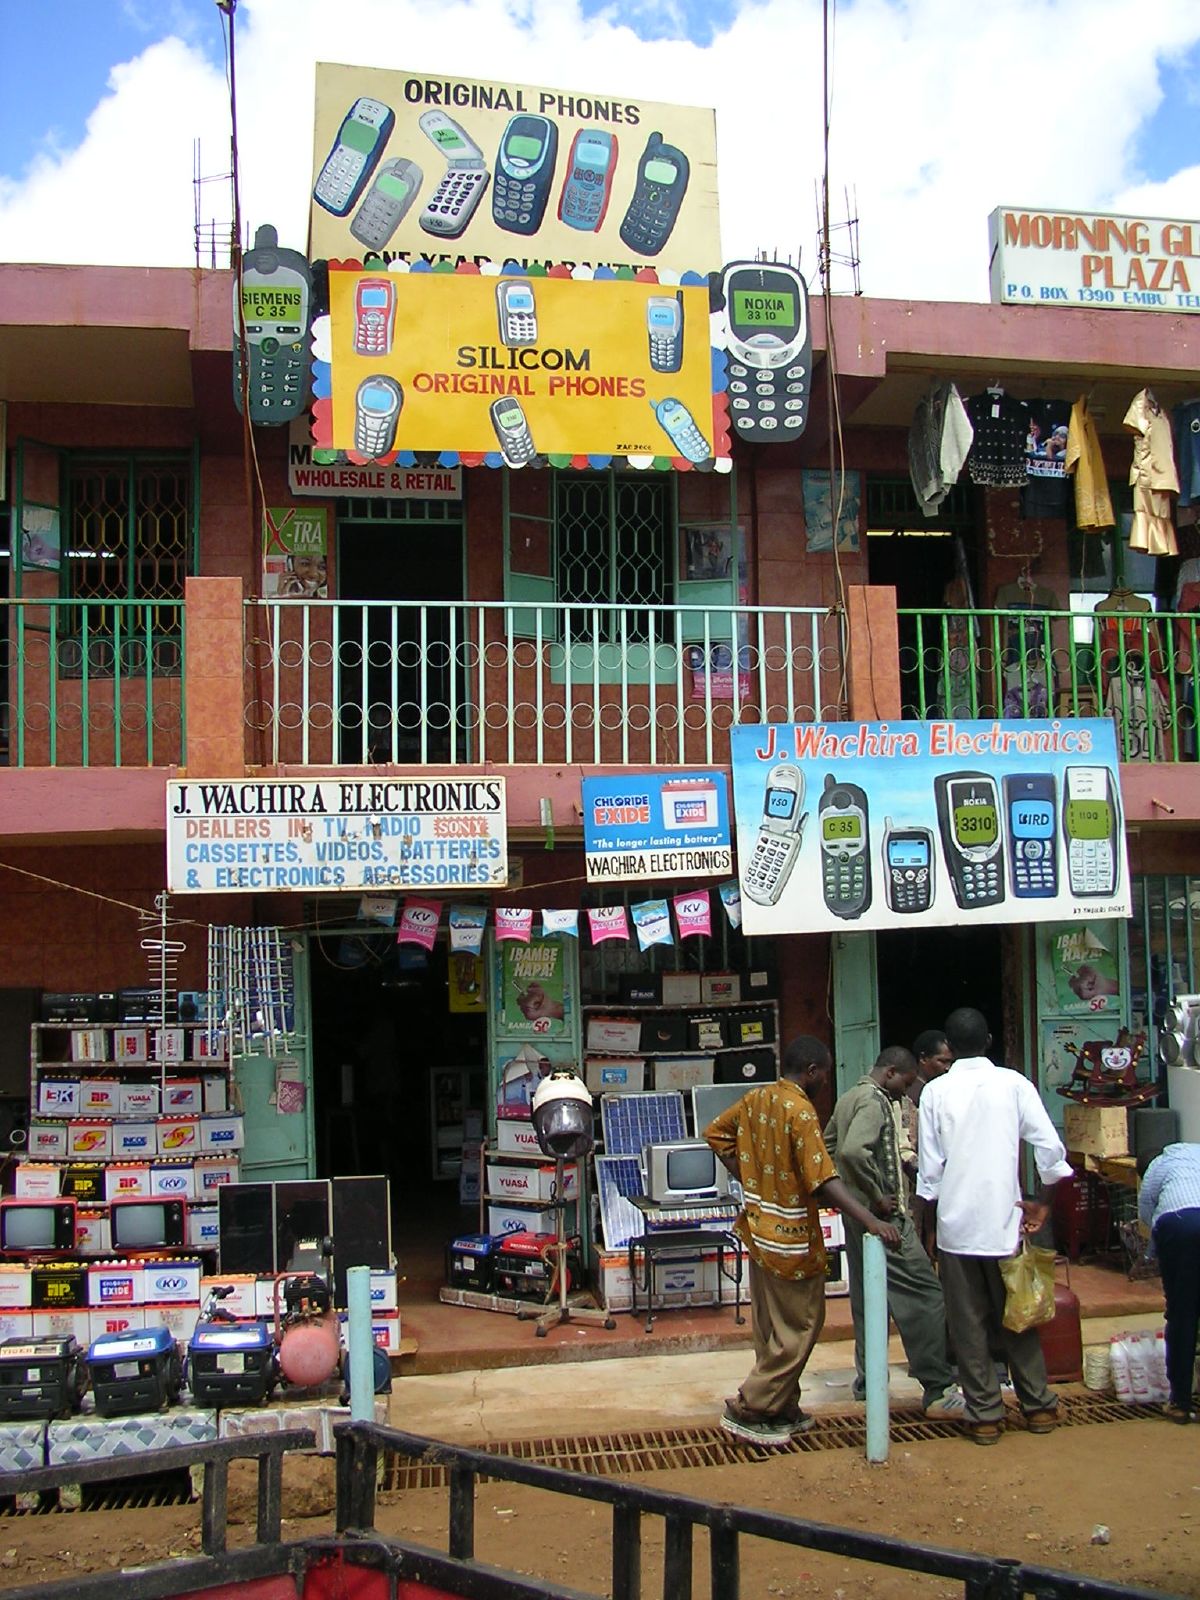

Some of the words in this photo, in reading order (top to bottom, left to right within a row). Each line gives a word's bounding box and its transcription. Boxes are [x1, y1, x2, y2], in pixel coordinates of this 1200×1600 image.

[404, 78, 528, 112] ORIGINAL
[540, 92, 641, 126] PHONES
[1005, 212, 1150, 255] MORNING
[1081, 254, 1191, 292] PLAZA
[242, 292, 302, 306] SIEMENS
[1039, 286, 1069, 300] BOX
[1077, 289, 1114, 303] 1390
[1122, 291, 1167, 306] EMBU
[744, 298, 785, 312] NOKIA
[456, 345, 591, 371] SILICOM
[412, 373, 536, 397] ORIGINAL
[549, 376, 646, 397] PHONES
[295, 470, 385, 488] WHOLESALE
[390, 473, 402, 490] &
[405, 473, 456, 491] RETAIL
[756, 727, 788, 760] J.
[794, 724, 920, 760] Wachira
[928, 720, 1093, 756] Electronics
[173, 785, 191, 814] J.
[201, 784, 328, 814] WACHIRA
[338, 782, 501, 813] ELECTRONICS
[593, 795, 649, 807] CHLORIDE
[963, 797, 987, 806] NOKIA
[593, 806, 651, 826] EXIDE
[676, 808, 705, 818] EXIDE
[185, 818, 271, 839] DEALERS
[365, 816, 422, 838] RADIO
[436, 818, 484, 836] SONY
[961, 816, 992, 832] 3310
[616, 837, 647, 850] longer
[650, 835, 682, 847] lasting
[185, 841, 303, 864] CASSETTES,
[315, 840, 389, 863] VIDEOS,
[400, 839, 501, 860] BATTERIES
[587, 855, 647, 876] WACHIRA
[650, 850, 730, 873] ELECTRONICS
[186, 867, 200, 888] &
[216, 864, 345, 888] ELECTRONICS
[362, 863, 490, 886] ACCESSORIES
[504, 908, 522, 917] KV
[597, 907, 615, 918] KV
[683, 903, 701, 913] KV
[411, 911, 431, 921] KV
[509, 947, 559, 962] IBAMBE
[165, 1179, 180, 1187] KV
[499, 1177, 529, 1188] YUASA
[162, 1278, 181, 1288] KV
[102, 1286, 129, 1296] EXIDE
